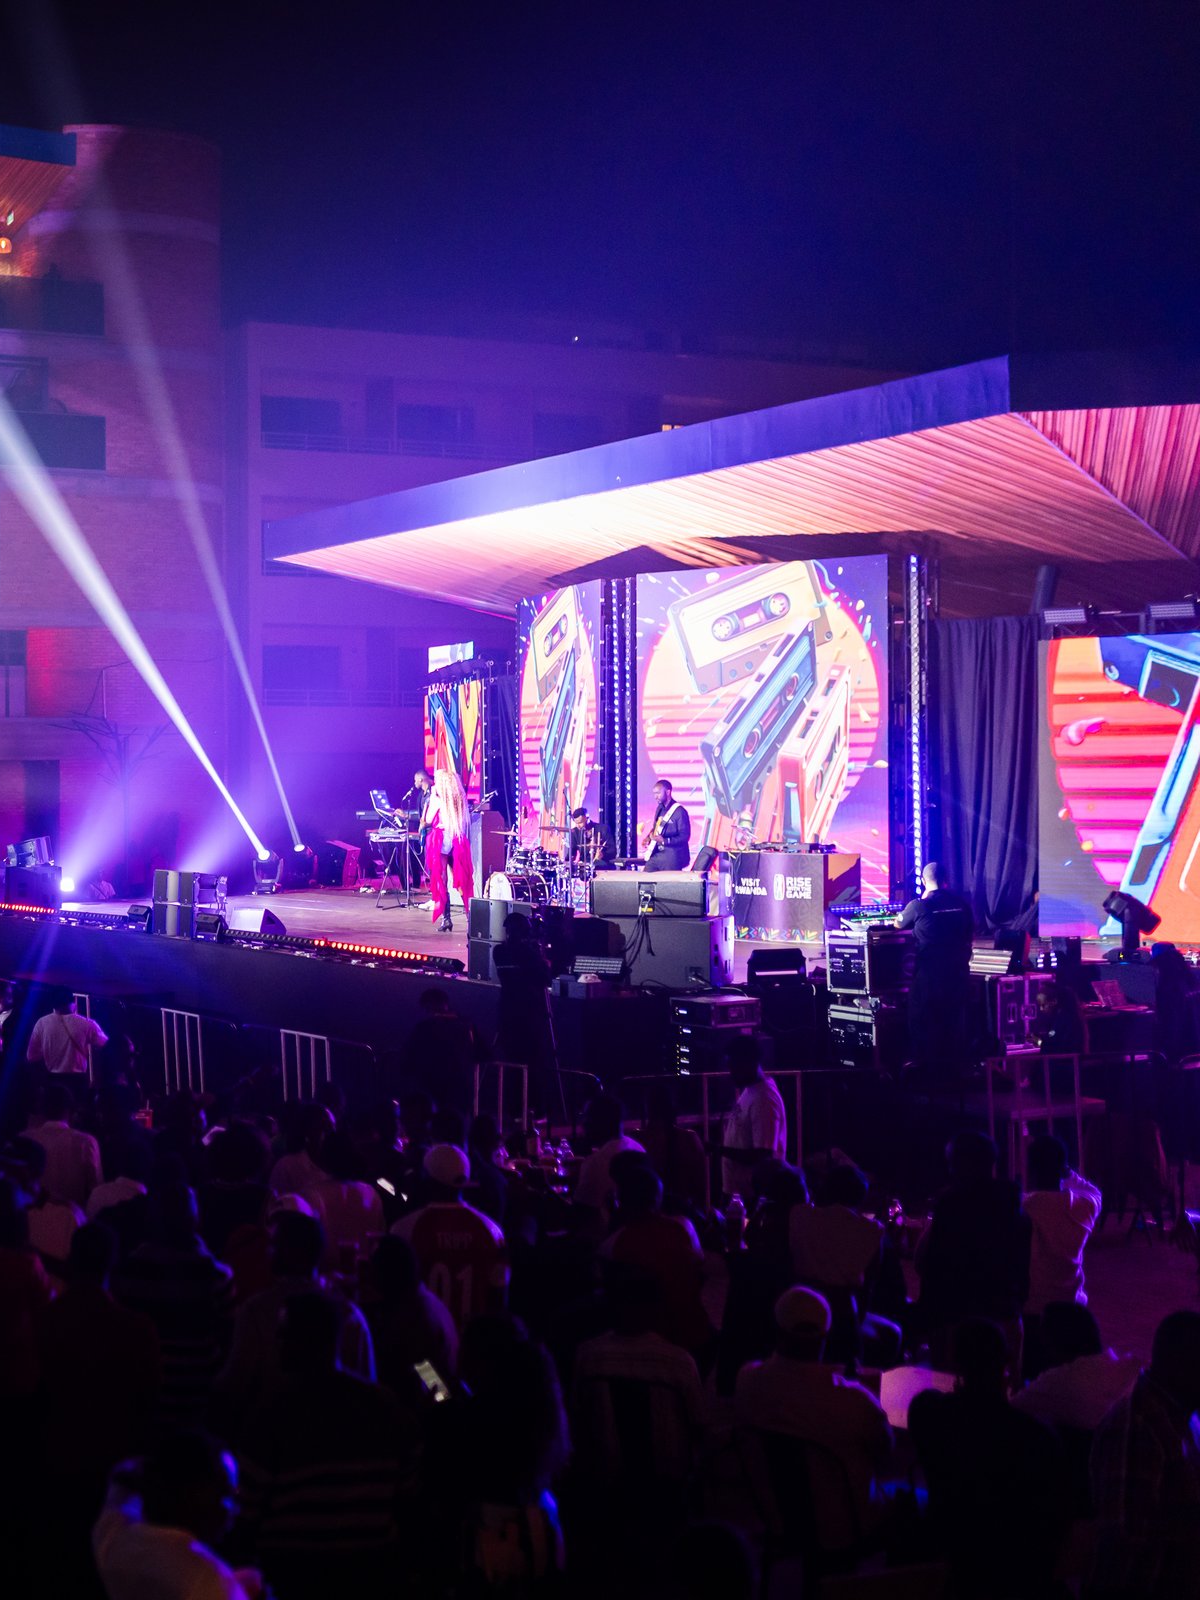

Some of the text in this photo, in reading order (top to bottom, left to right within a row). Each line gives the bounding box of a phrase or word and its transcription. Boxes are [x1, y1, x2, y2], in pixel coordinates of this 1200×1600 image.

[740, 878, 760, 887] VISIT
[786, 877, 812, 887] RISE
[735, 886, 767, 895] RWANDA
[786, 891, 812, 899] GAME
